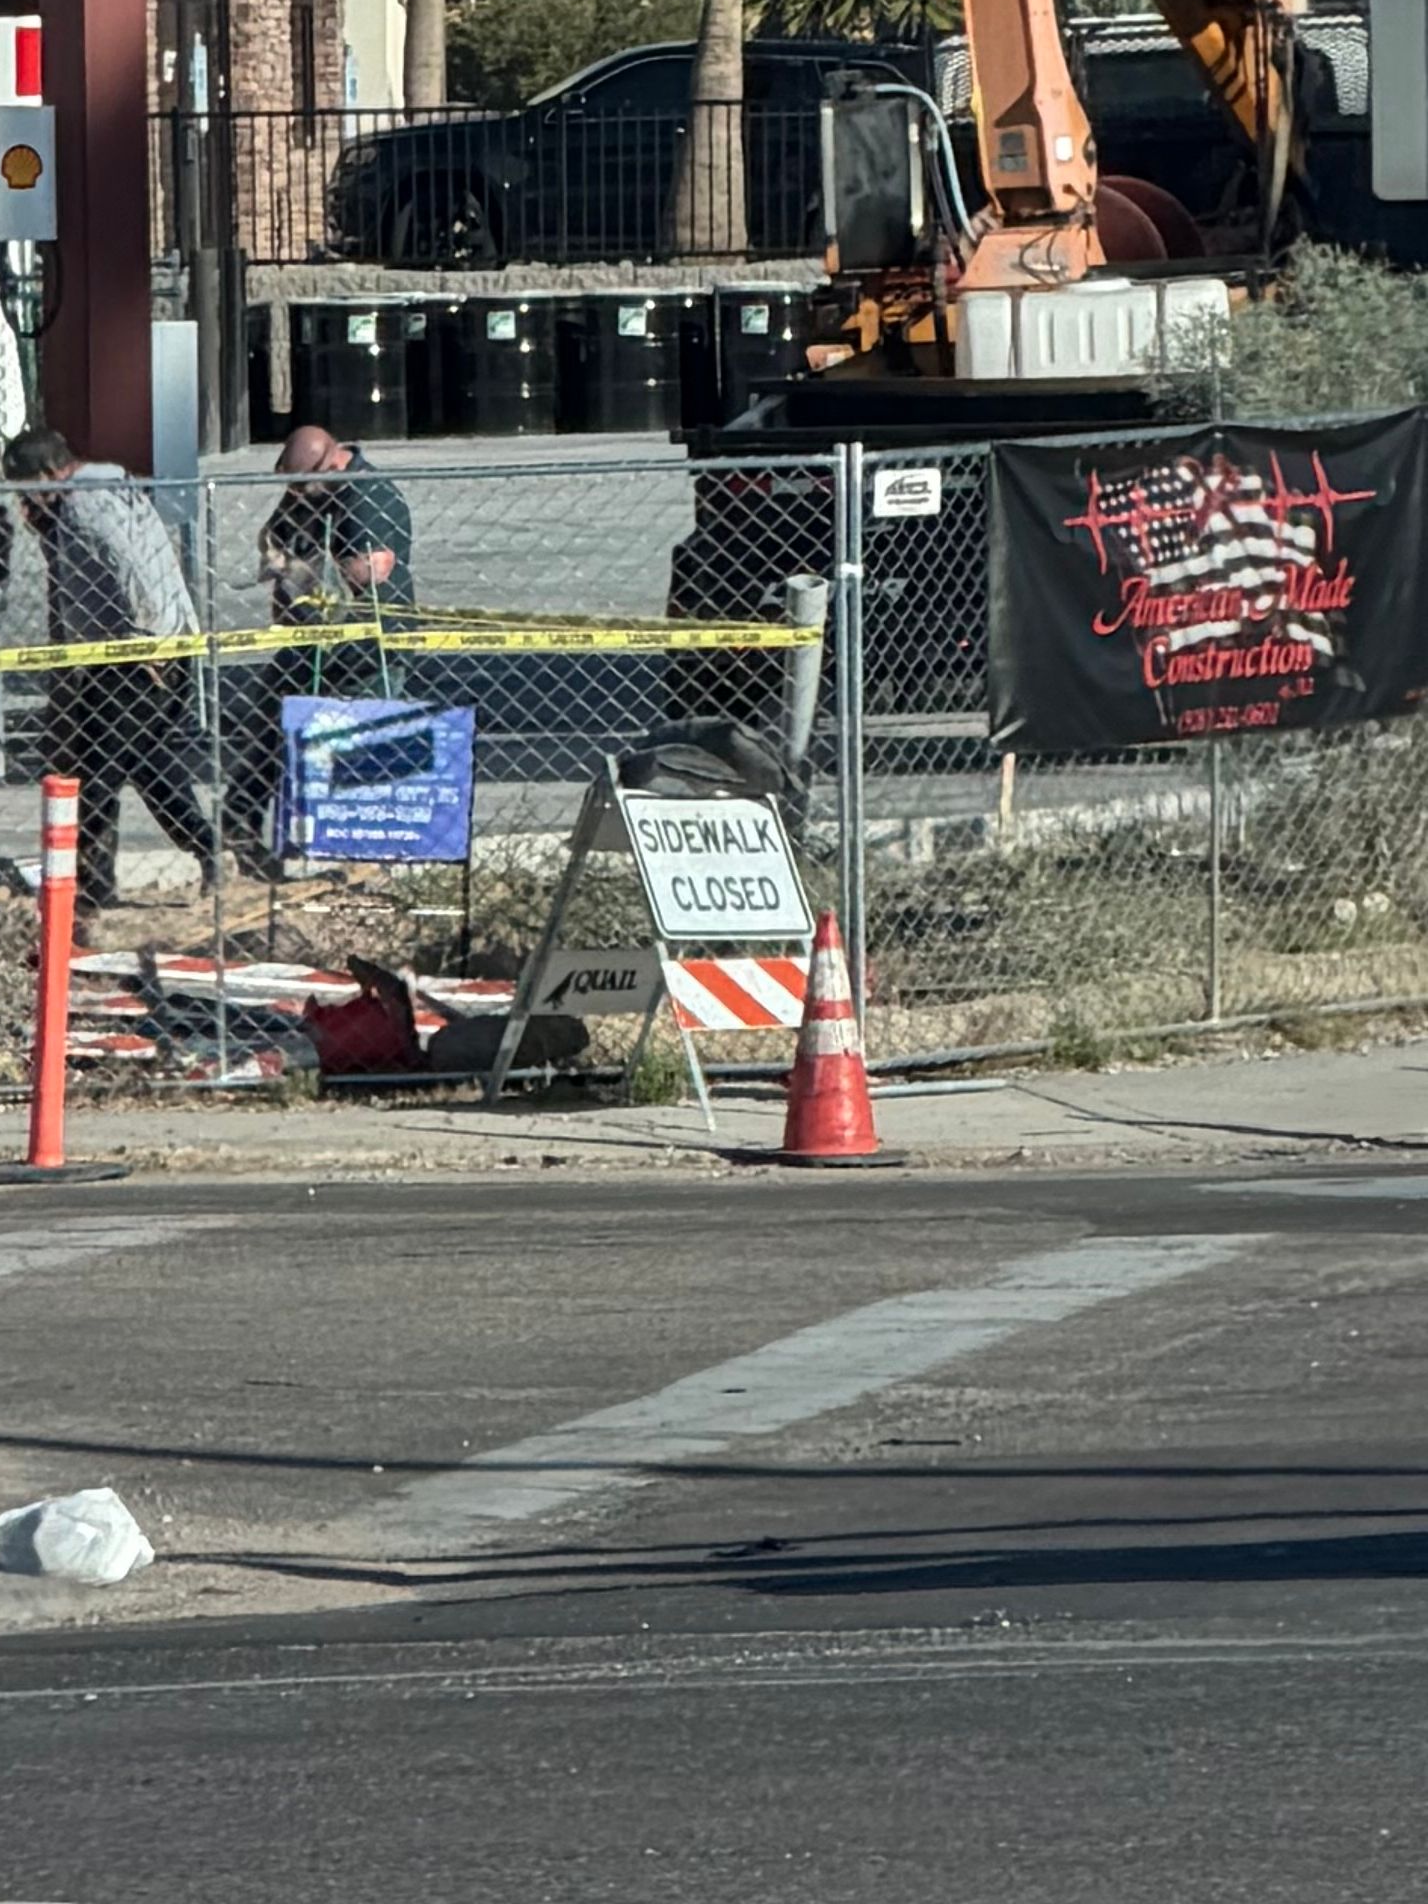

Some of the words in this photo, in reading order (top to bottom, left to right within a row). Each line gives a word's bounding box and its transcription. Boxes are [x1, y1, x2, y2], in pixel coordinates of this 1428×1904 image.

[1093, 576, 1242, 636] American
[1248, 557, 1356, 621] Made
[1144, 635, 1313, 689] Construction
[637, 818, 779, 854] SIDEWALK
[671, 876, 781, 912] CLOSED
[574, 969, 638, 992] QUAIL
